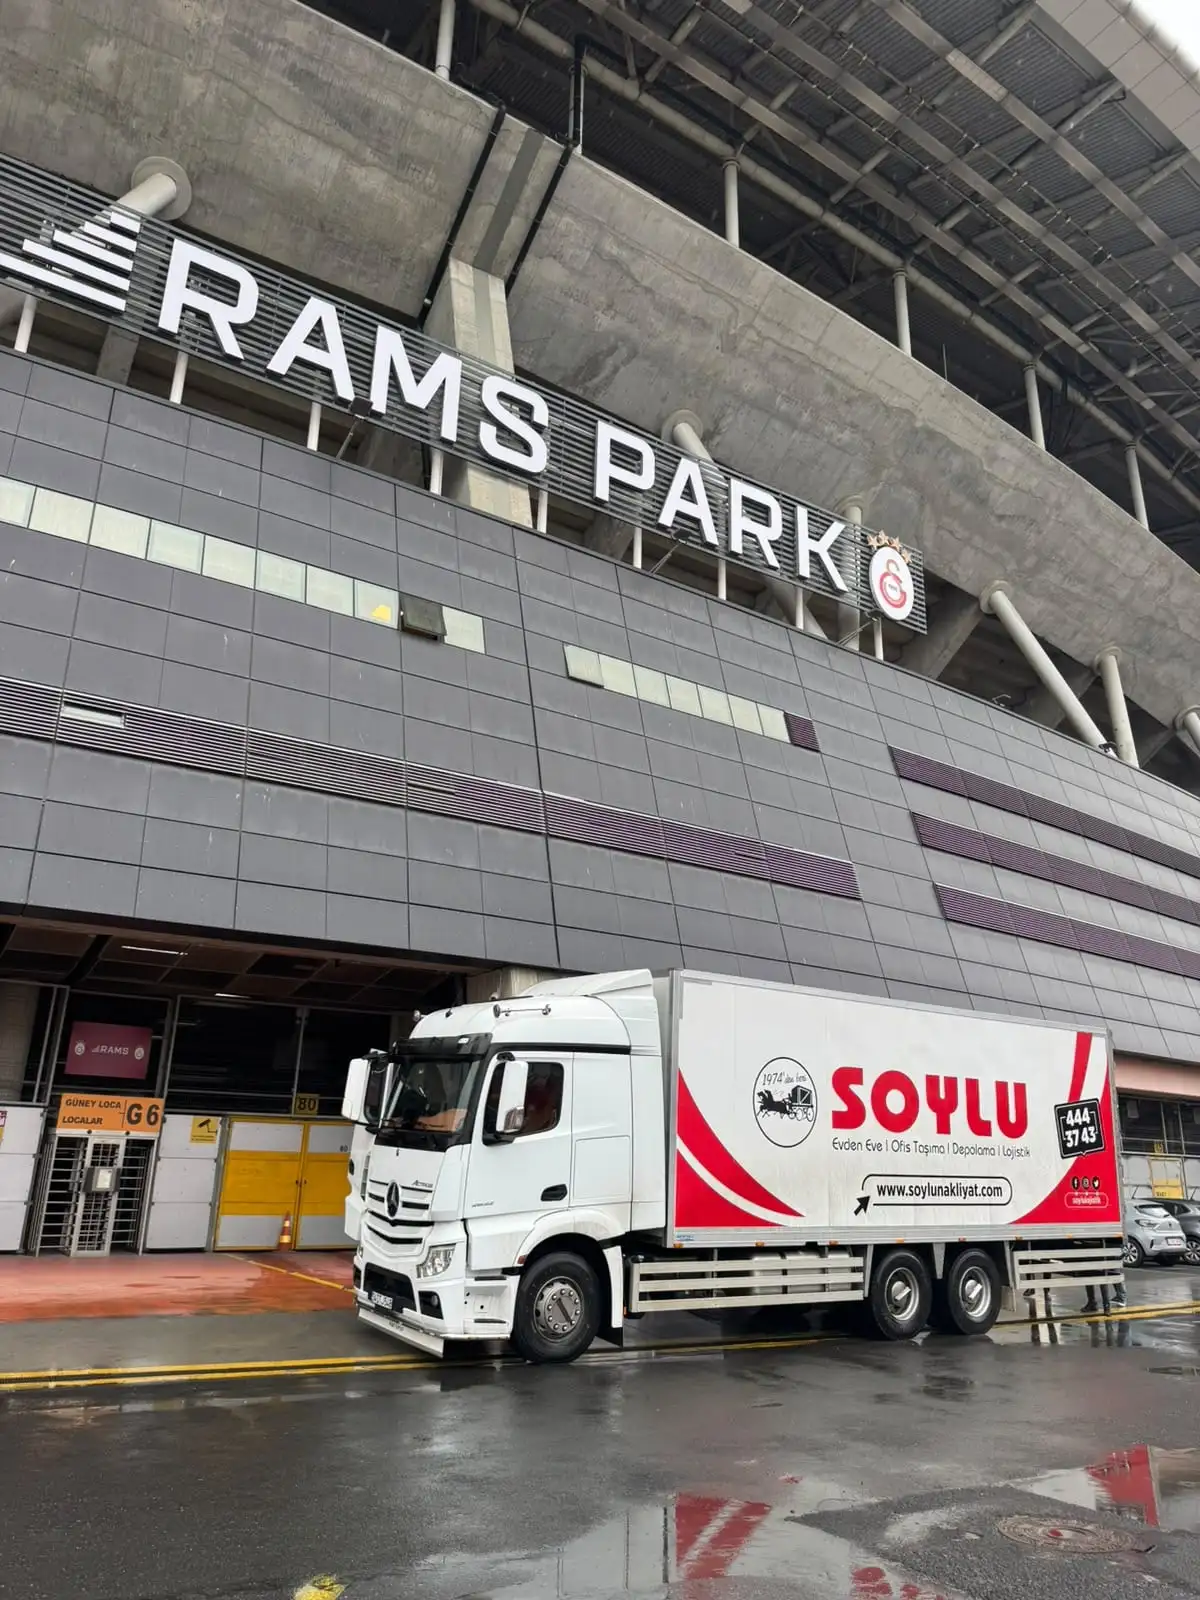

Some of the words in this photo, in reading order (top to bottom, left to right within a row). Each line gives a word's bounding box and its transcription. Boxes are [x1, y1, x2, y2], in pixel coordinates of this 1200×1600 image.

[158, 238, 550, 474] RAMS
[594, 420, 849, 593] PARK
[100, 1045, 129, 1055] RAMS
[65, 1098, 97, 1108] GÜNEY
[98, 1100, 121, 1109] LOCA
[297, 1097, 317, 1111] 80
[831, 1066, 1028, 1139] SOYLU
[62, 1116, 103, 1125] LOCALAR
[1066, 1107, 1090, 1126] 444
[832, 1137, 863, 1152] Evden
[865, 1138, 883, 1152] Eve
[891, 1139, 911, 1153] Ofis
[913, 1140, 945, 1157] Taşıma
[952, 1142, 996, 1157] Depolama
[876, 1182, 1003, 1200] www.soylunakliyat.com
